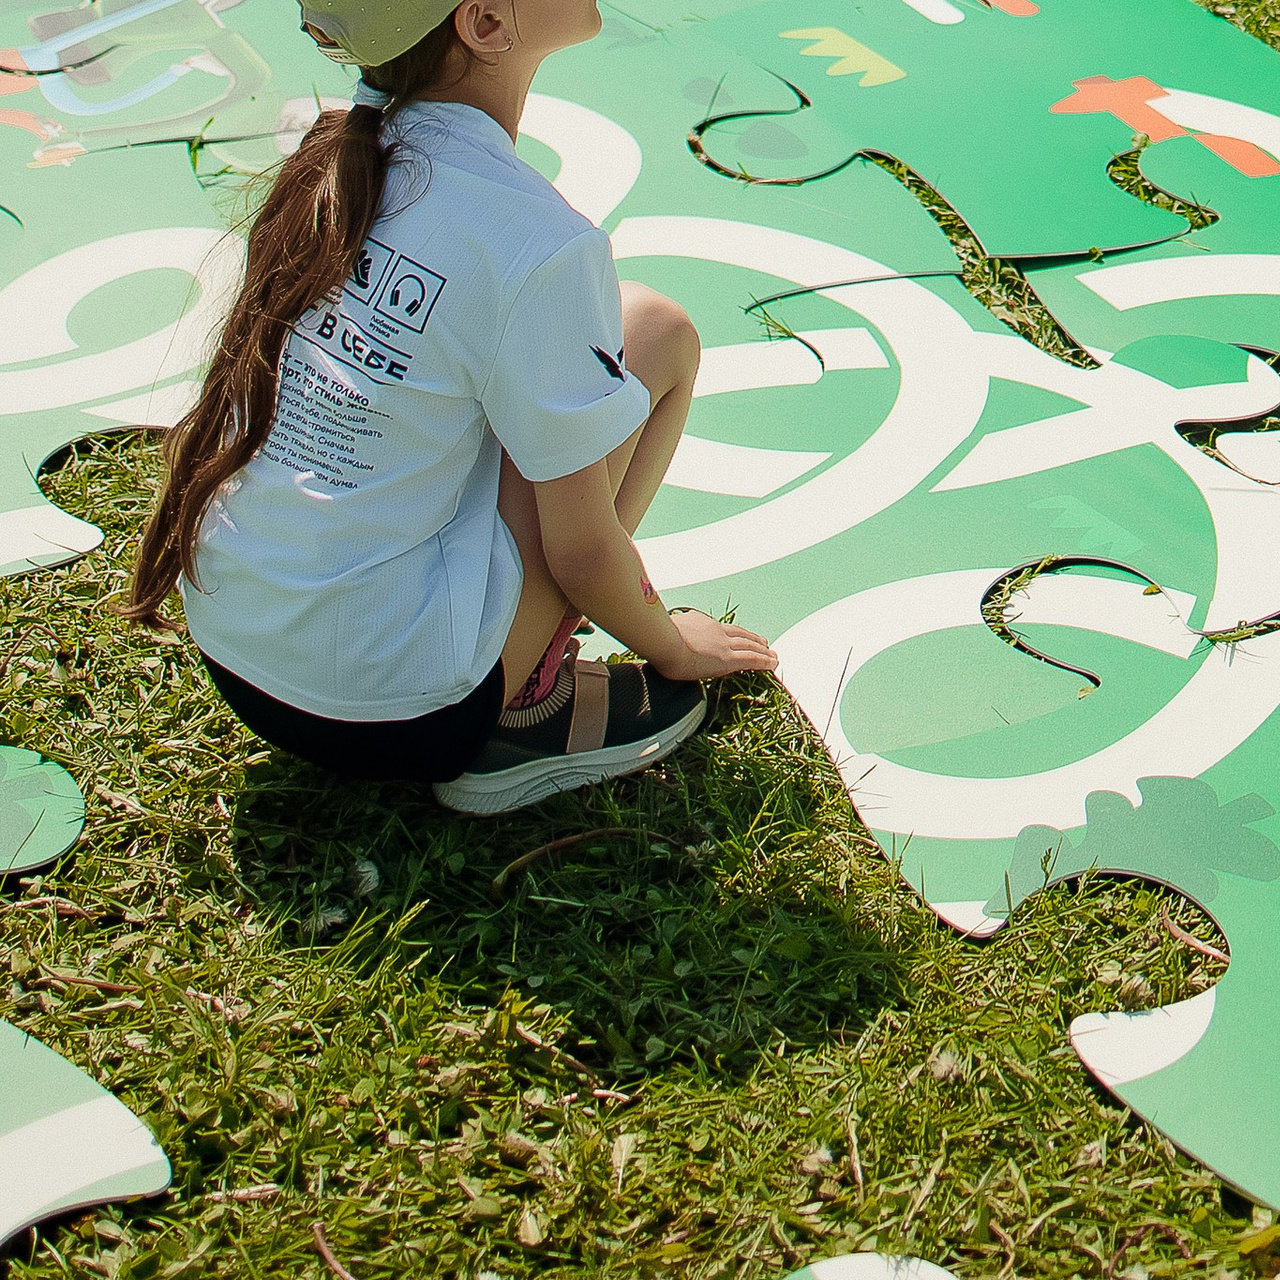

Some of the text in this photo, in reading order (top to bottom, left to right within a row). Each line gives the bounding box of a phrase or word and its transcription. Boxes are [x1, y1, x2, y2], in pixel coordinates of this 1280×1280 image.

[316, 312, 408, 381] В СЕБЕ
[314, 385, 343, 407] стиль
[318, 373, 329, 385] не
[331, 380, 370, 407] только
[288, 448, 298, 458] ты
[318, 436, 355, 454] Сначала
[317, 449, 328, 458] но
[337, 454, 375, 471] каждым
[329, 477, 358, 489] думал
